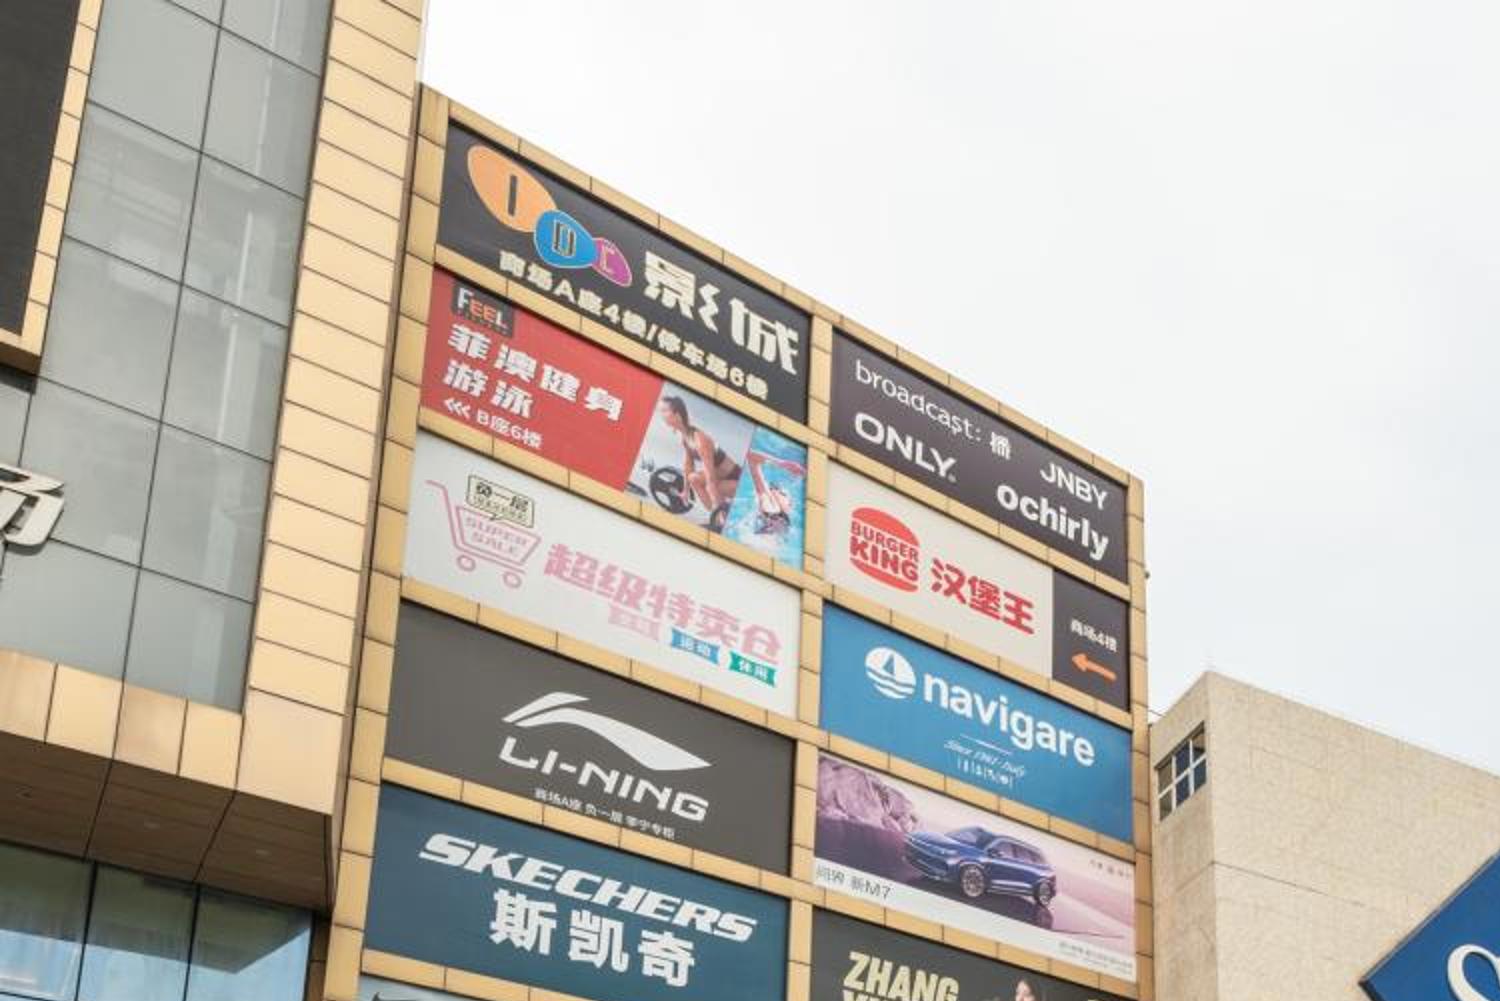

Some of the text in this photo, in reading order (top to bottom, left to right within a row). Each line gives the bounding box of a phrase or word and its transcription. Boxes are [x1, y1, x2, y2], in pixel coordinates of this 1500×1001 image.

[456, 286, 507, 327] FEEL
[442, 360, 534, 419] 游泳
[447, 323, 623, 422] 菲澳健身
[475, 408, 544, 450] B座6楼
[990, 430, 1011, 460] 播
[996, 484, 1109, 561] ochirly
[1040, 462, 1109, 510] JNBY
[849, 536, 919, 583] KING
[850, 519, 919, 563] BURGER
[543, 543, 783, 667] 超级特卖仓
[930, 557, 1035, 636] 汉堡王
[923, 671, 1096, 768] navigare
[499, 736, 710, 823] LI-NING
[418, 832, 758, 943] SKECHERS
[489, 887, 696, 988] 斯凯奇
